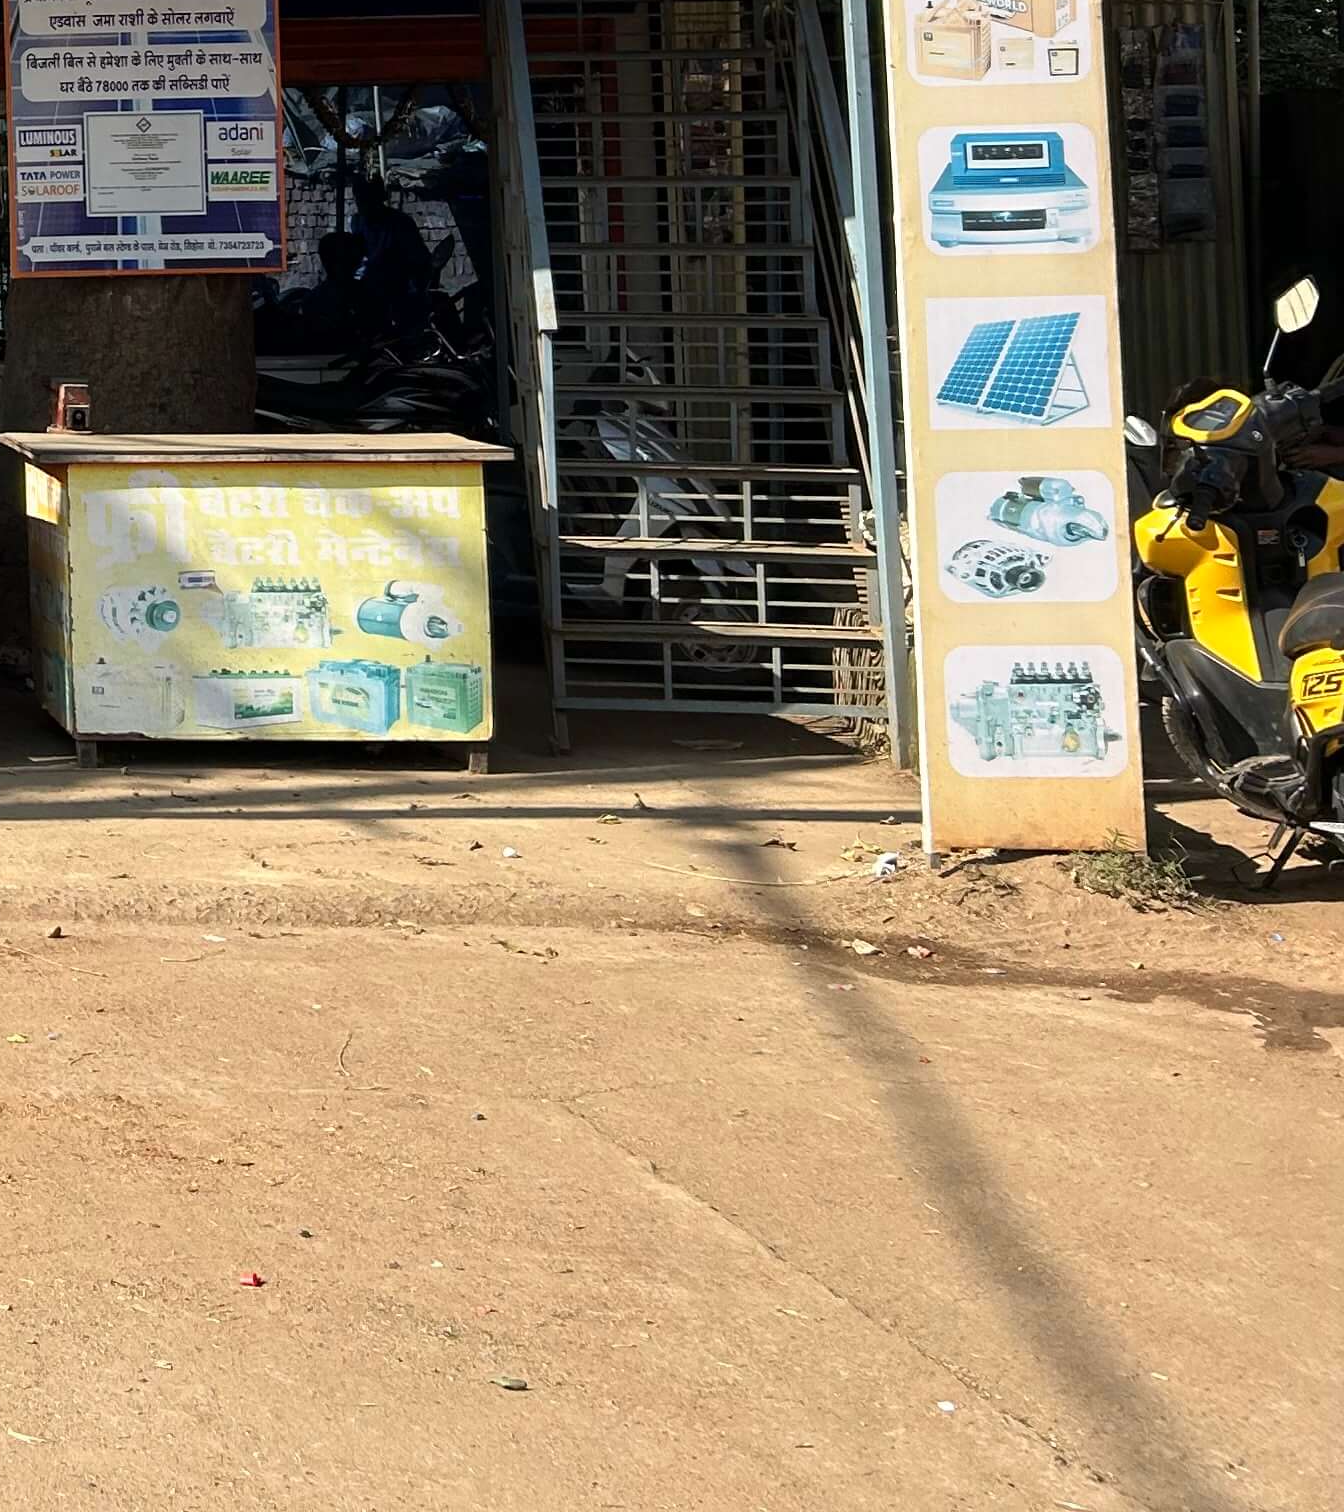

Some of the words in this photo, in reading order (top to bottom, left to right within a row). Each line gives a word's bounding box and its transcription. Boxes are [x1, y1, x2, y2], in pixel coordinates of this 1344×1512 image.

[92, 14, 116, 28] जमा
[147, 9, 159, 26] के
[161, 8, 192, 26] सोलर
[25, 53, 61, 70] बिजली
[63, 52, 84, 69] बिल
[86, 53, 97, 68] से
[99, 52, 129, 68] हमेशा
[130, 51, 142, 67] के
[144, 51, 166, 68] लिए
[195, 49, 206, 65] के
[59, 80, 75, 93] घर
[95, 79, 129, 93] 78000
[131, 79, 149, 92] तक
[151, 75, 166, 92] की
[19, 129, 76, 146] LUMINOUS
[217, 122, 265, 142] adani
[19, 171, 47, 181] TATA
[49, 170, 81, 180] POWER
[210, 170, 273, 185] WAAREE
[1302, 672, 1343, 698] 125
